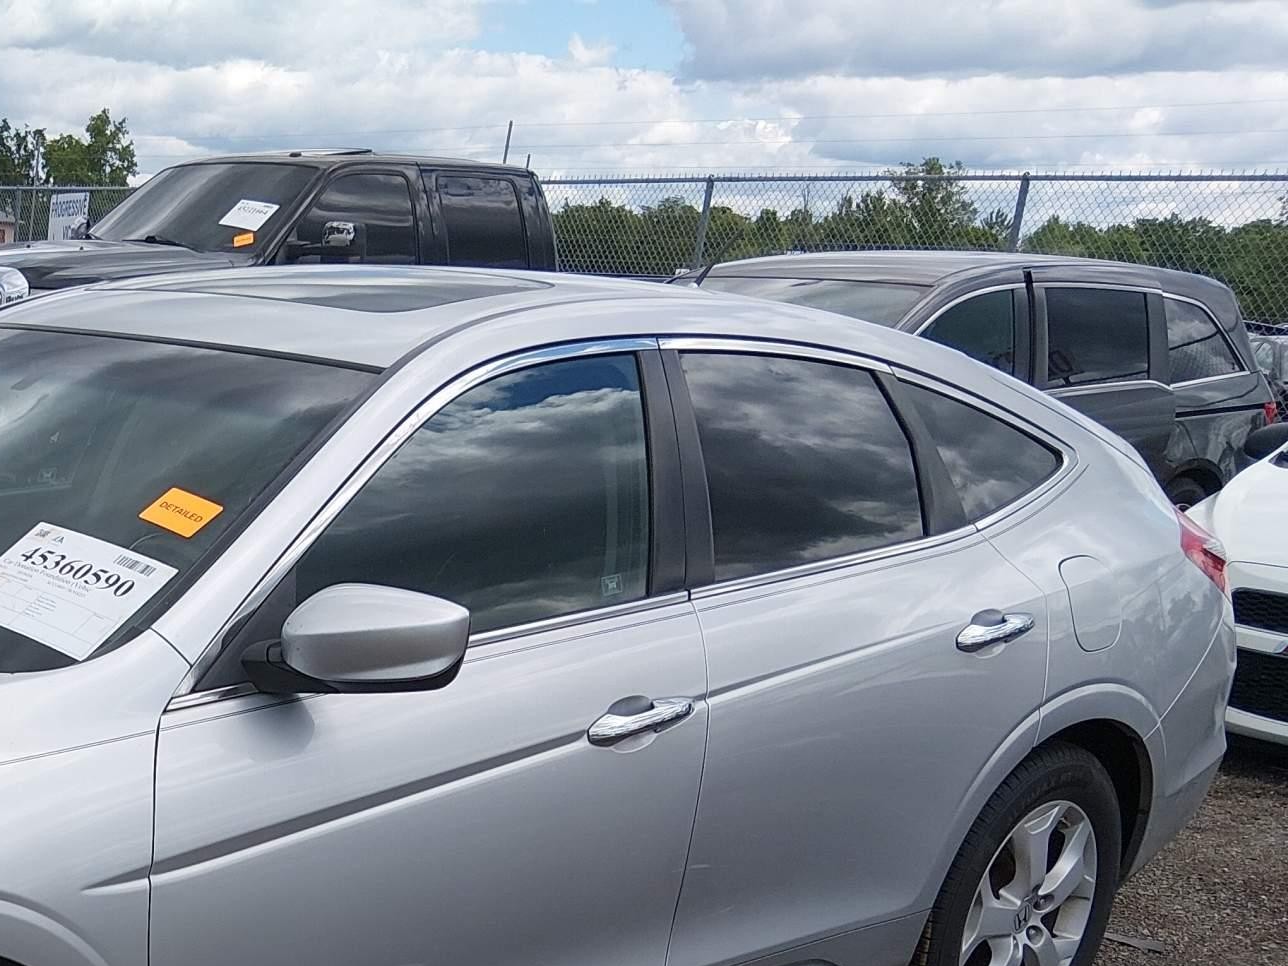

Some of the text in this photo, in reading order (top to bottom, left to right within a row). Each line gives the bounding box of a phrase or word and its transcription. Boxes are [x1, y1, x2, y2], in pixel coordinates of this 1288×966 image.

[51, 198, 88, 219] PROGRESSIVE
[159, 501, 204, 524] DETAILED
[21, 546, 136, 598] 45360590
